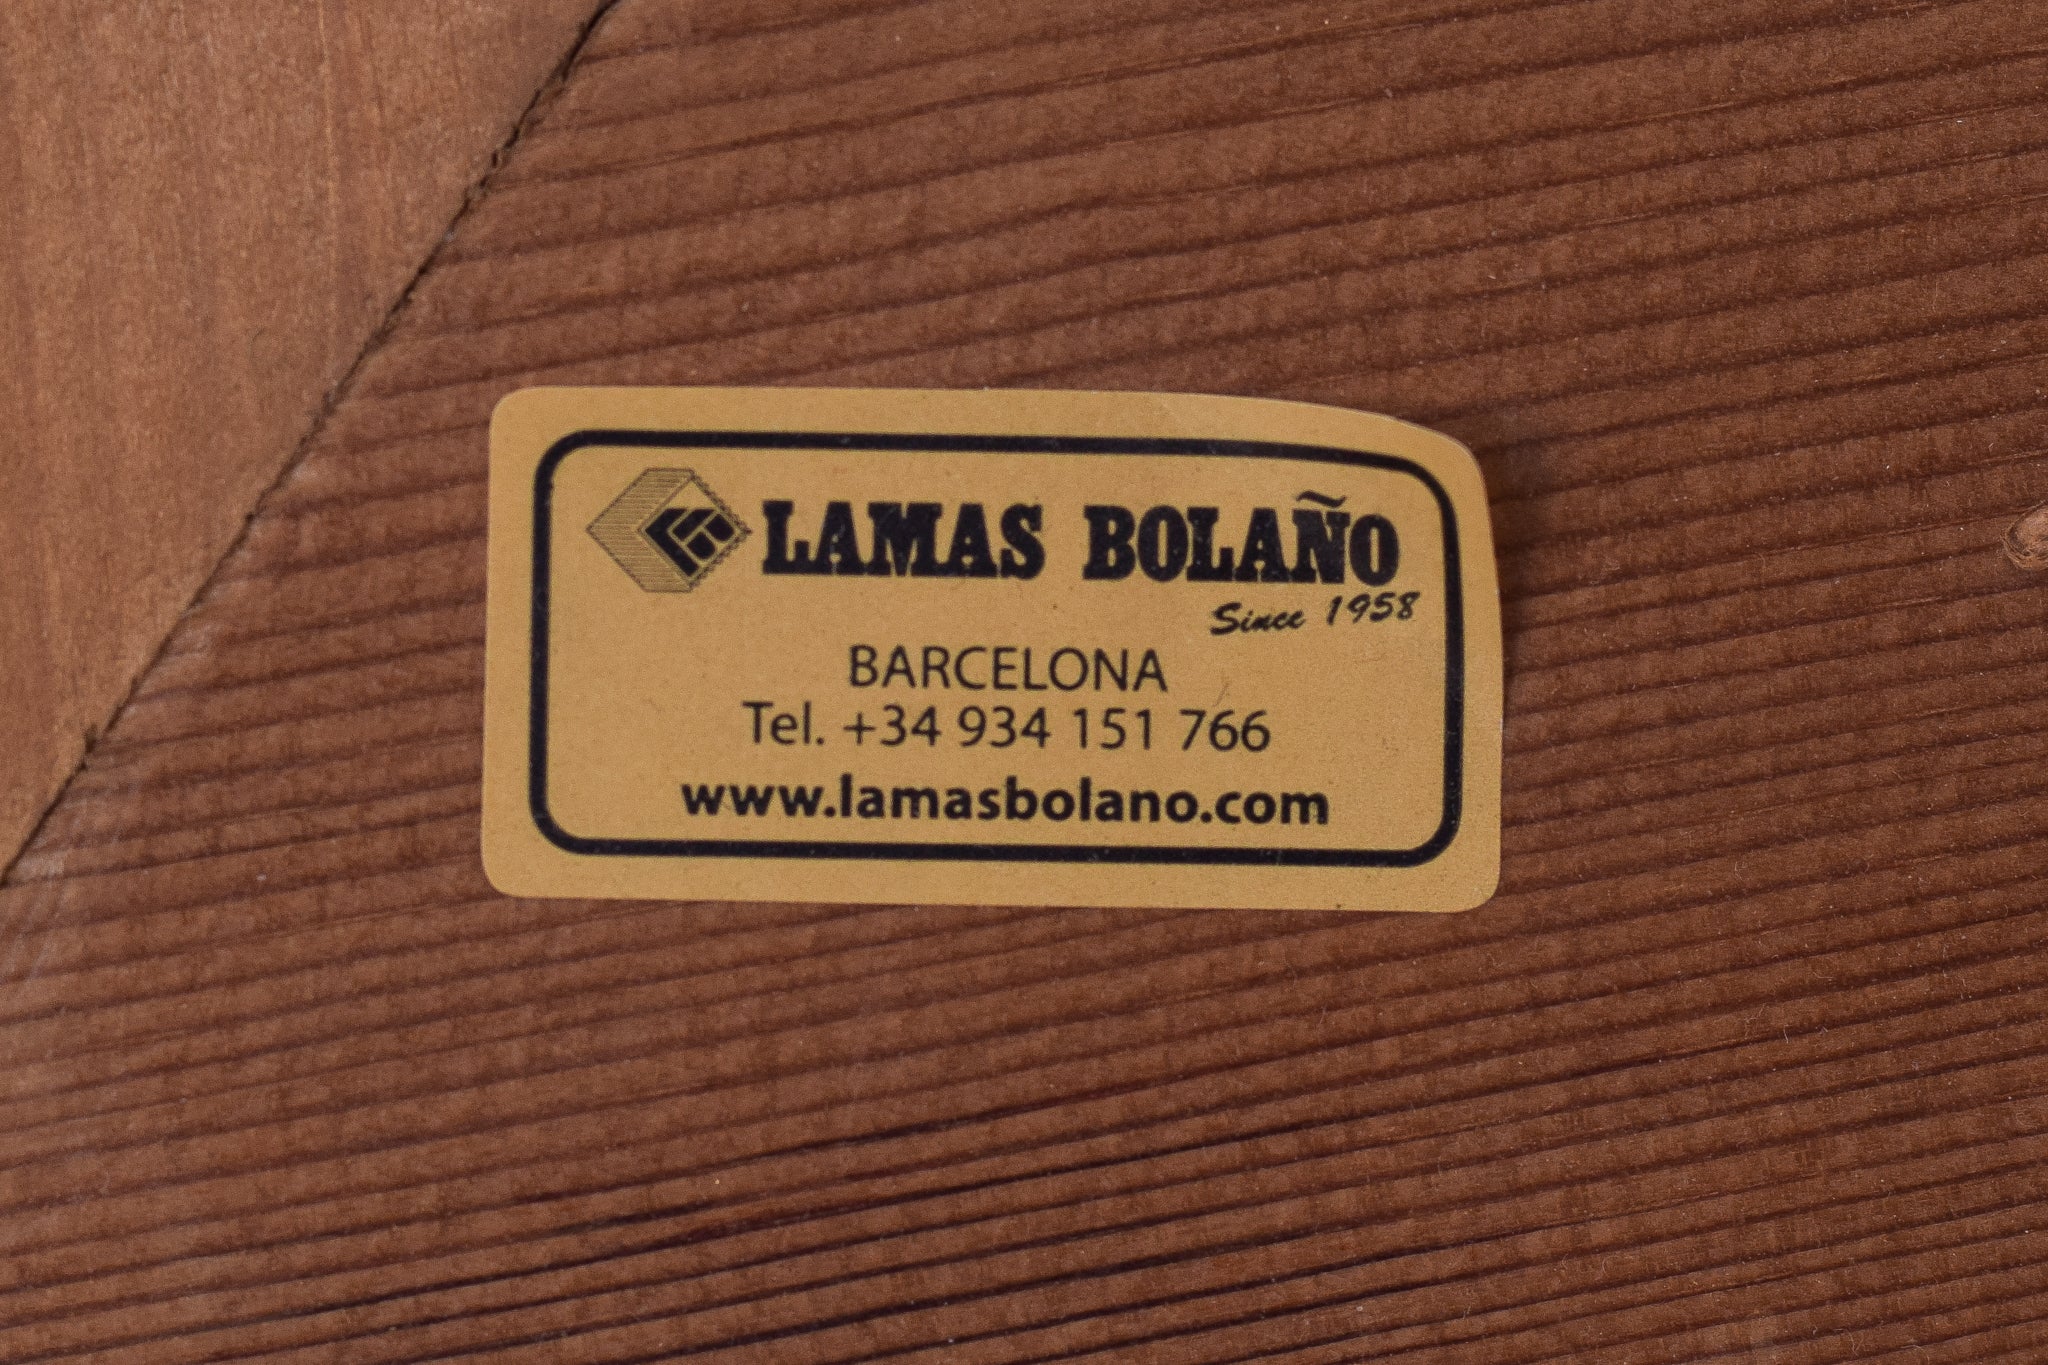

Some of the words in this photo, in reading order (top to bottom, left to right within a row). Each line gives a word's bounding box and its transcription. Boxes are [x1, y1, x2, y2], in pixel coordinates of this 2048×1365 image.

[762, 499, 1046, 581] LAMAS
[1082, 489, 1401, 588] BOLAÑO
[1209, 601, 1307, 636] Since
[1326, 590, 1421, 626] 1958
[848, 644, 1169, 693] BARCELONA
[742, 700, 826, 746] Tel.
[842, 704, 942, 747] +34
[957, 705, 1051, 749] 934
[1073, 707, 1153, 751] 151
[1179, 708, 1273, 753] 766
[681, 772, 1331, 827] www.lamasbolano.com
